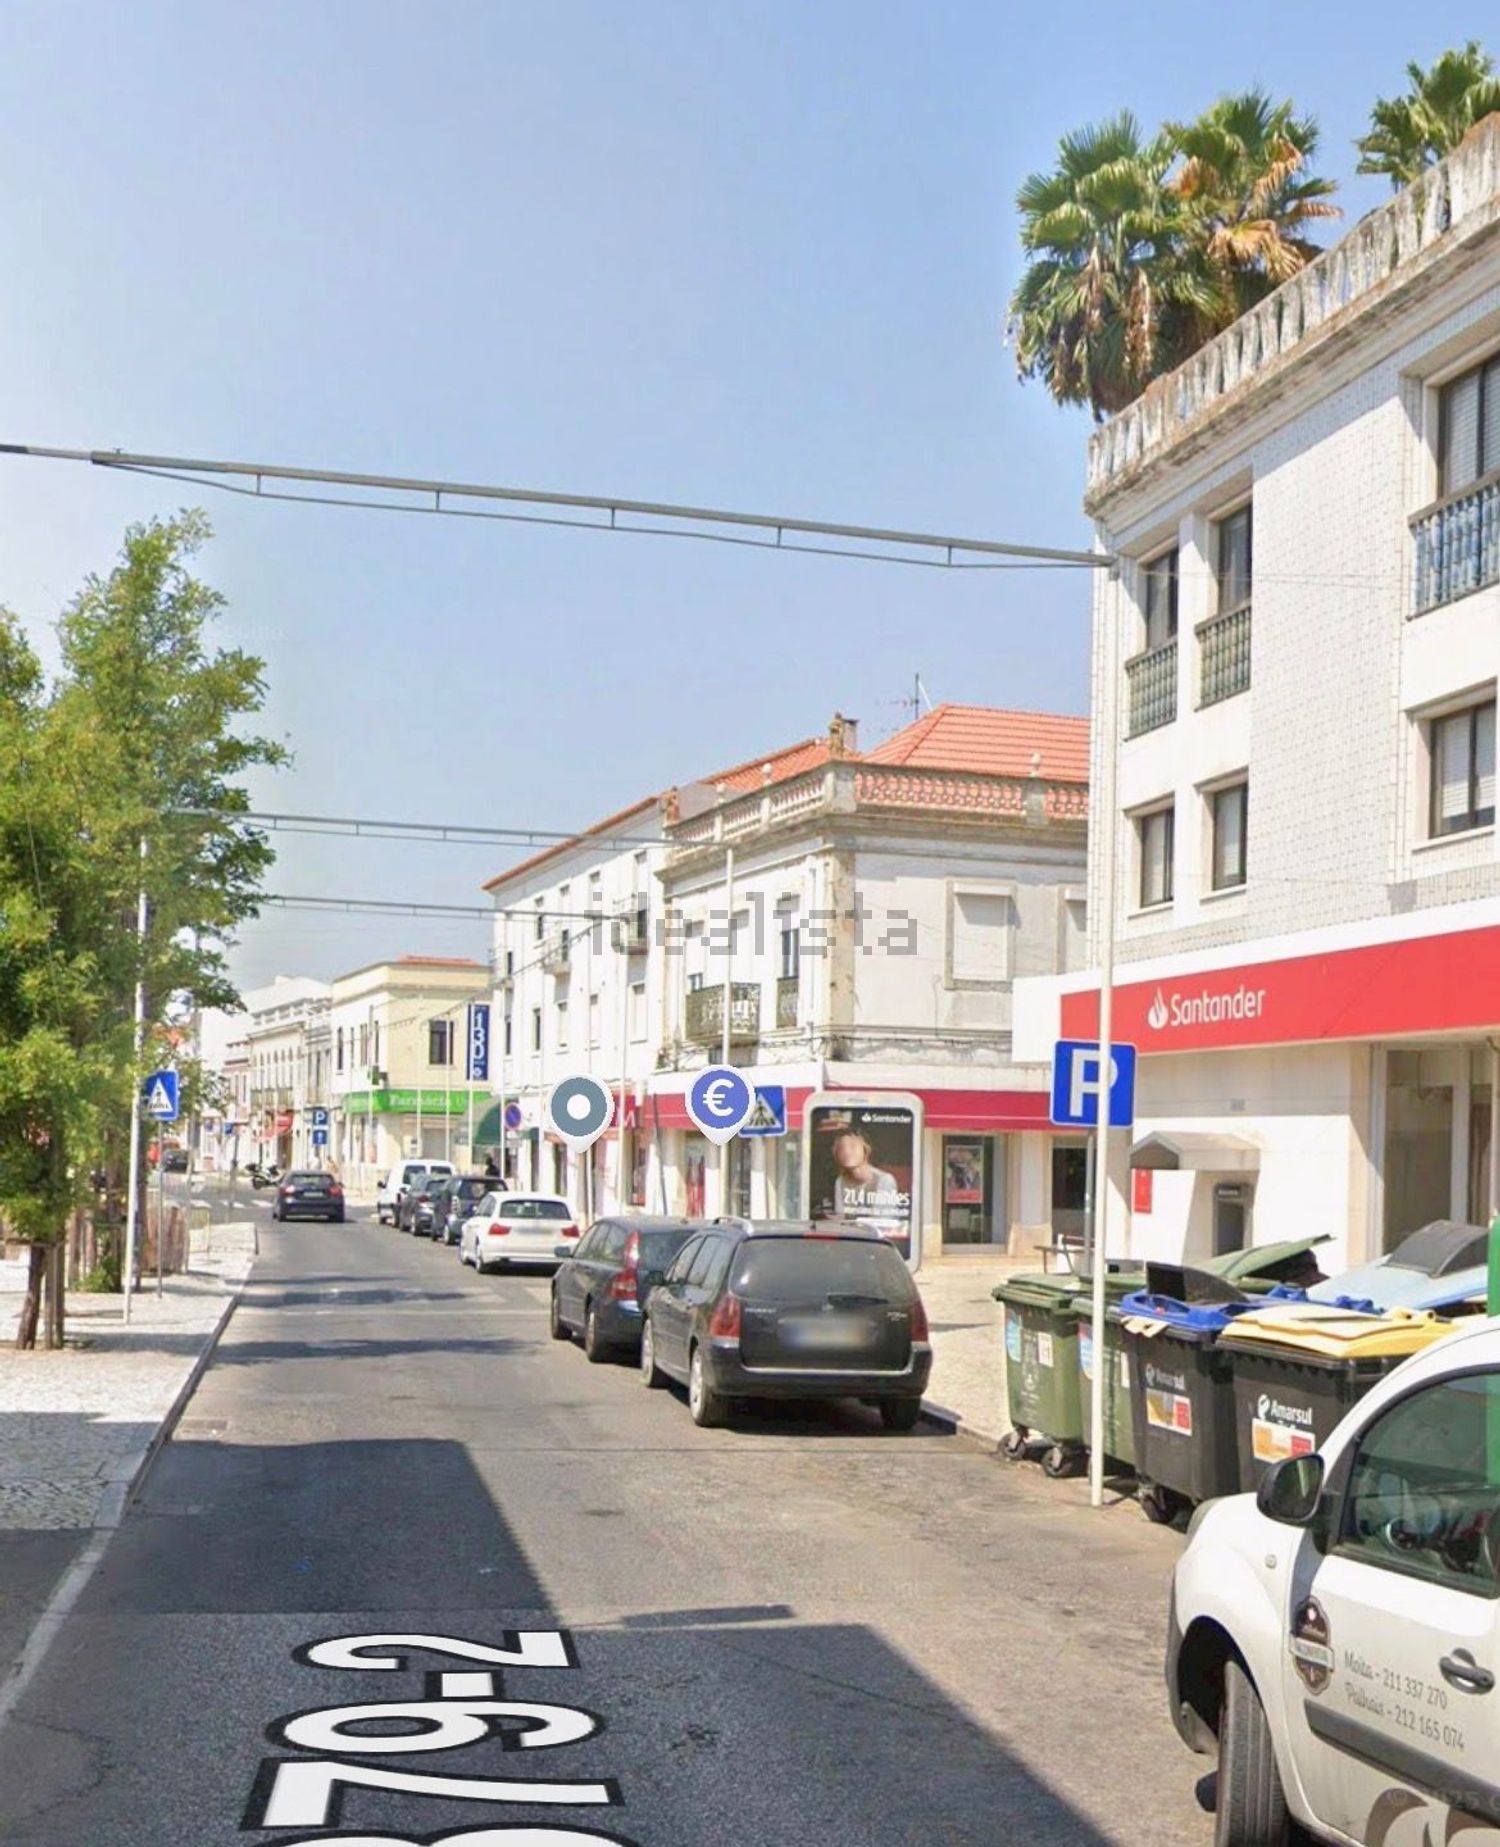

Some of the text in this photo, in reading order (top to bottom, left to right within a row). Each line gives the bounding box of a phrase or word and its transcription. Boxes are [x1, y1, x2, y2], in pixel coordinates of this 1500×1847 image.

[1169, 986, 1267, 1027] Santander
[1069, 1048, 1118, 1118] P
[1270, 1399, 1313, 1426] Amarsul
[1344, 1649, 1374, 1681] Moita
[1383, 1668, 1403, 1692] 211
[1405, 1676, 1424, 1702] 337
[1428, 1685, 1449, 1711] 270
[1395, 1704, 1415, 1731] 212
[1443, 1724, 1466, 1753] 074
